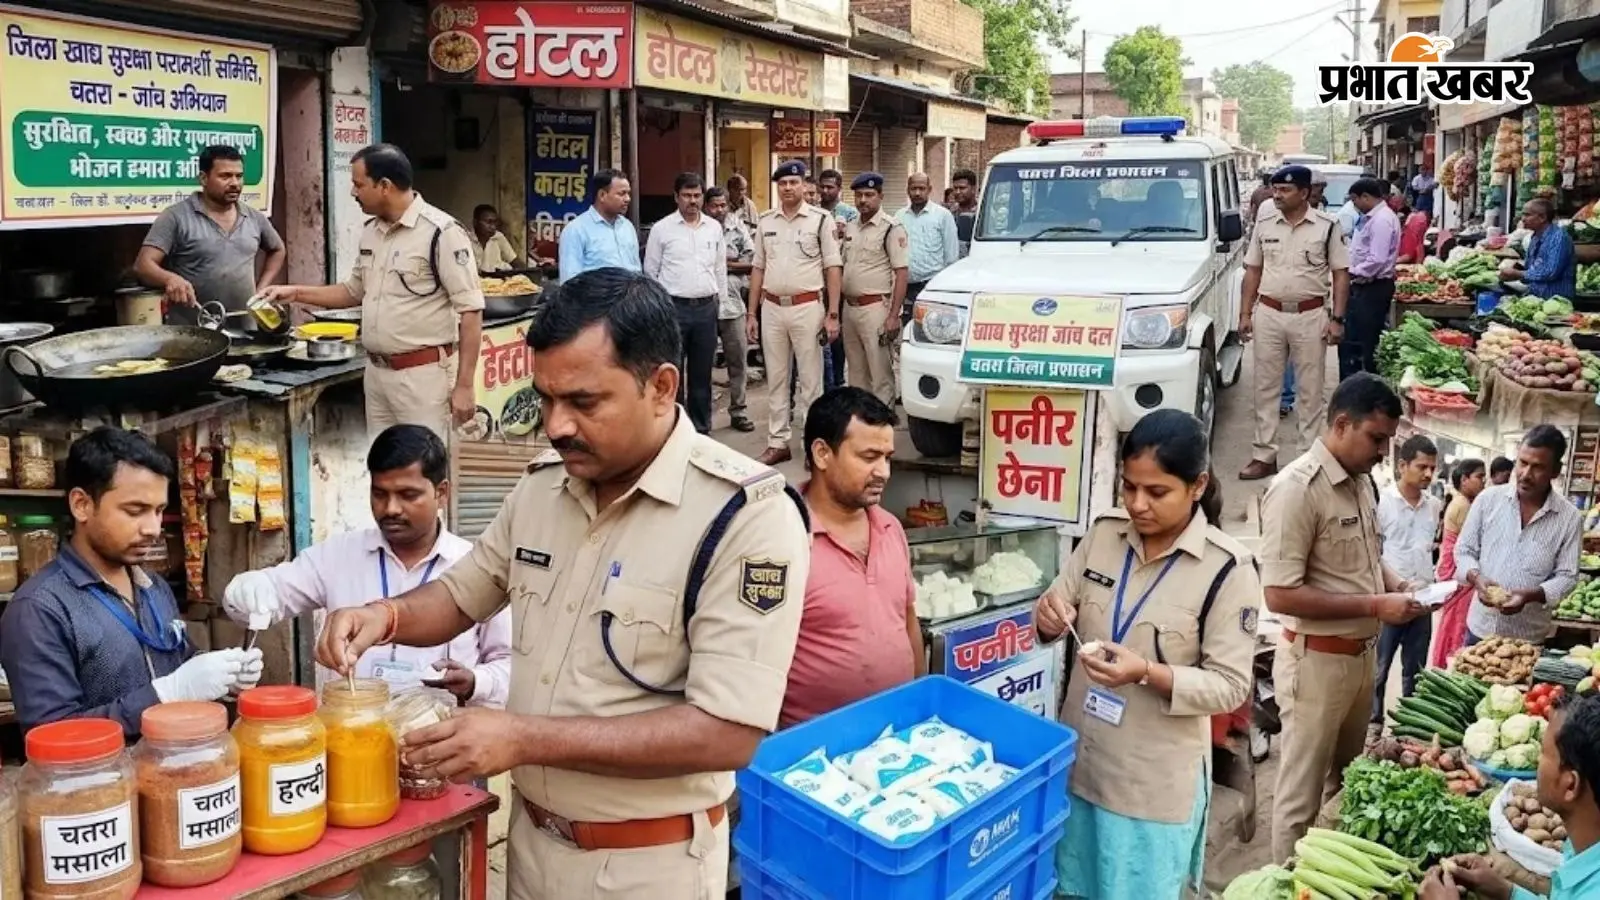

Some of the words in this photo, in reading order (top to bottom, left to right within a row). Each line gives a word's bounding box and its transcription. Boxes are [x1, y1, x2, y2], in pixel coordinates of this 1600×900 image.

[6, 24, 57, 60] जिला
[62, 40, 102, 64] खाद्य
[107, 46, 152, 77] सुरक्षा
[156, 50, 211, 77] परामर्शी
[215, 53, 262, 85] समिति,
[483, 6, 624, 79] होटल
[646, 20, 717, 84] होटल
[70, 81, 112, 105] चतरा
[131, 80, 165, 108] जांच
[170, 83, 227, 113] अभियान
[22, 117, 100, 150] सुरक्षित,
[104, 125, 149, 146] स्वच्छ
[151, 122, 181, 147] और
[536, 126, 590, 159] होटल
[69, 152, 124, 178] भोजन
[126, 159, 172, 178] हमारा
[534, 164, 589, 204] कढ़ाई
[1009, 323, 1049, 348] सुरक्षा
[1052, 320, 1084, 345] जांच
[1088, 326, 1114, 347] दल
[1007, 355, 1045, 376] जिला
[991, 395, 1077, 447] पनीर
[997, 451, 1067, 502] छेना
[953, 620, 1036, 672] पनीर
[998, 670, 1045, 702] छेना
[193, 785, 237, 812] चतरा
[276, 763, 324, 804] हल्दी
[58, 817, 118, 845] चतरा
[186, 808, 240, 839] मसाला
[51, 842, 127, 874] मसाला
